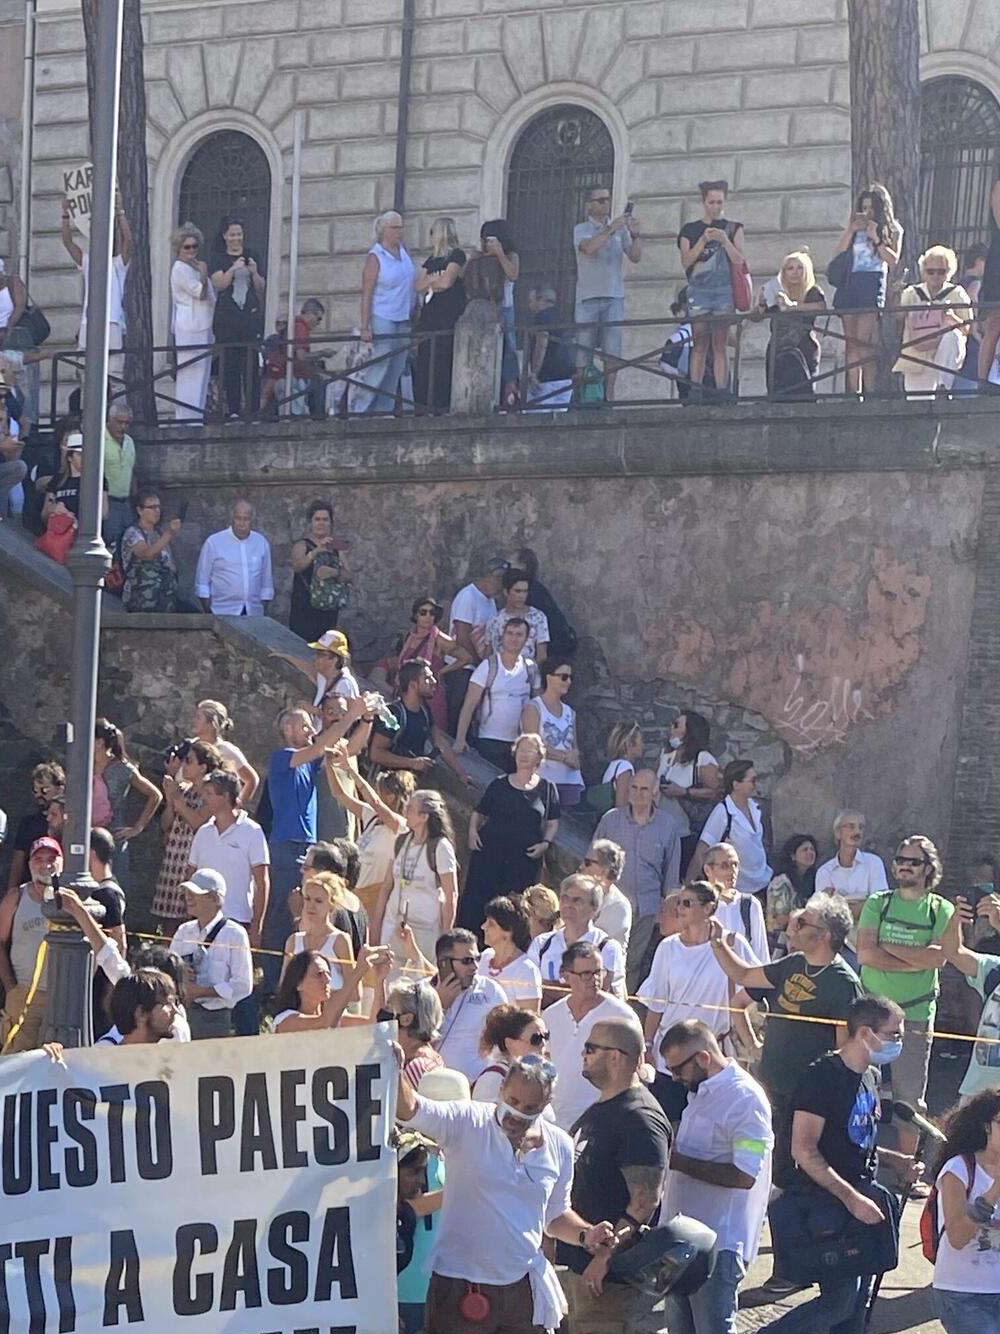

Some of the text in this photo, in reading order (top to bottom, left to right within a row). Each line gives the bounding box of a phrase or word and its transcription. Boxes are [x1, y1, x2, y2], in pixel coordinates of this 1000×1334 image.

[198, 1063, 382, 1176] PAESE
[102, 1229, 145, 1327] A
[172, 1206, 358, 1316] CASA
